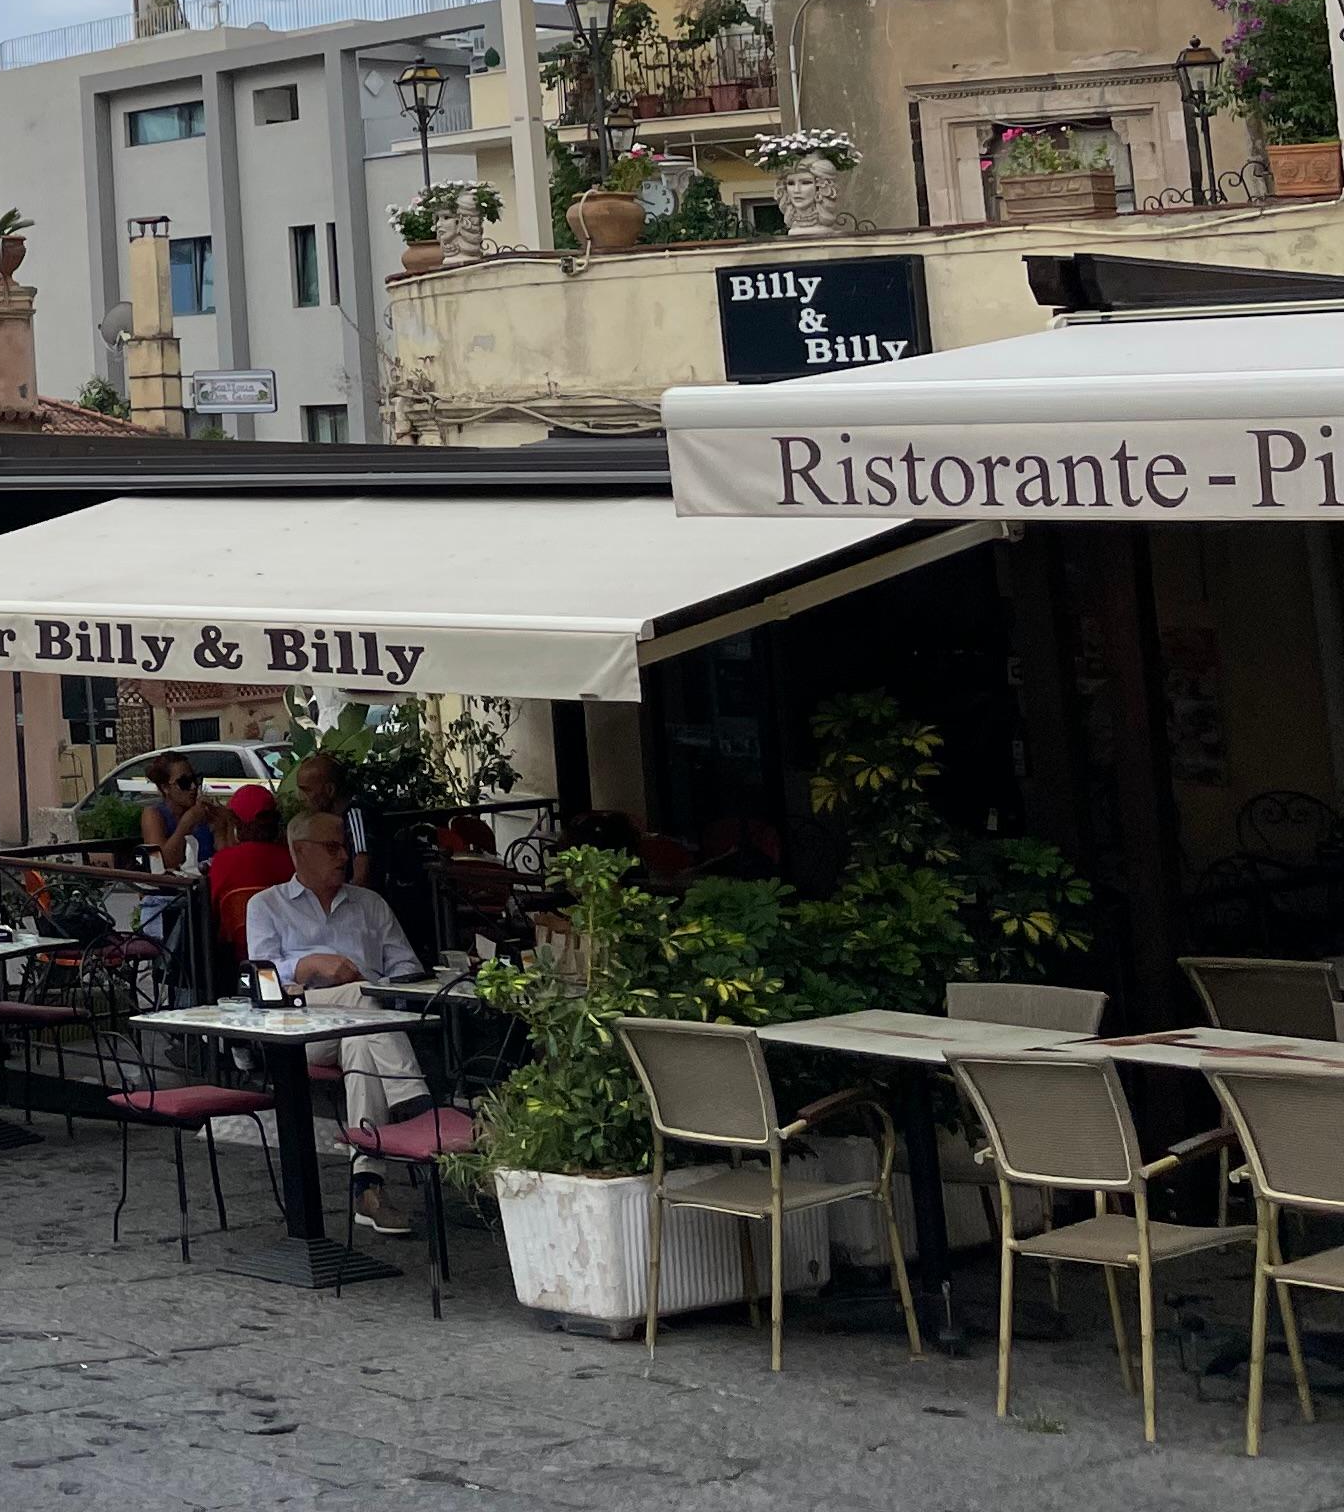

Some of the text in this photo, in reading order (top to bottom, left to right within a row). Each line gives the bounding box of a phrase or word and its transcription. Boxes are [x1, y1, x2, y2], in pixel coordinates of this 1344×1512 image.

[729, 270, 822, 304] Billy
[798, 308, 829, 334] &
[804, 334, 909, 364] Billy
[770, 432, 1189, 509] Ristorante
[34, 619, 174, 672] Billy
[193, 624, 244, 670] &
[263, 627, 425, 686] Billy
